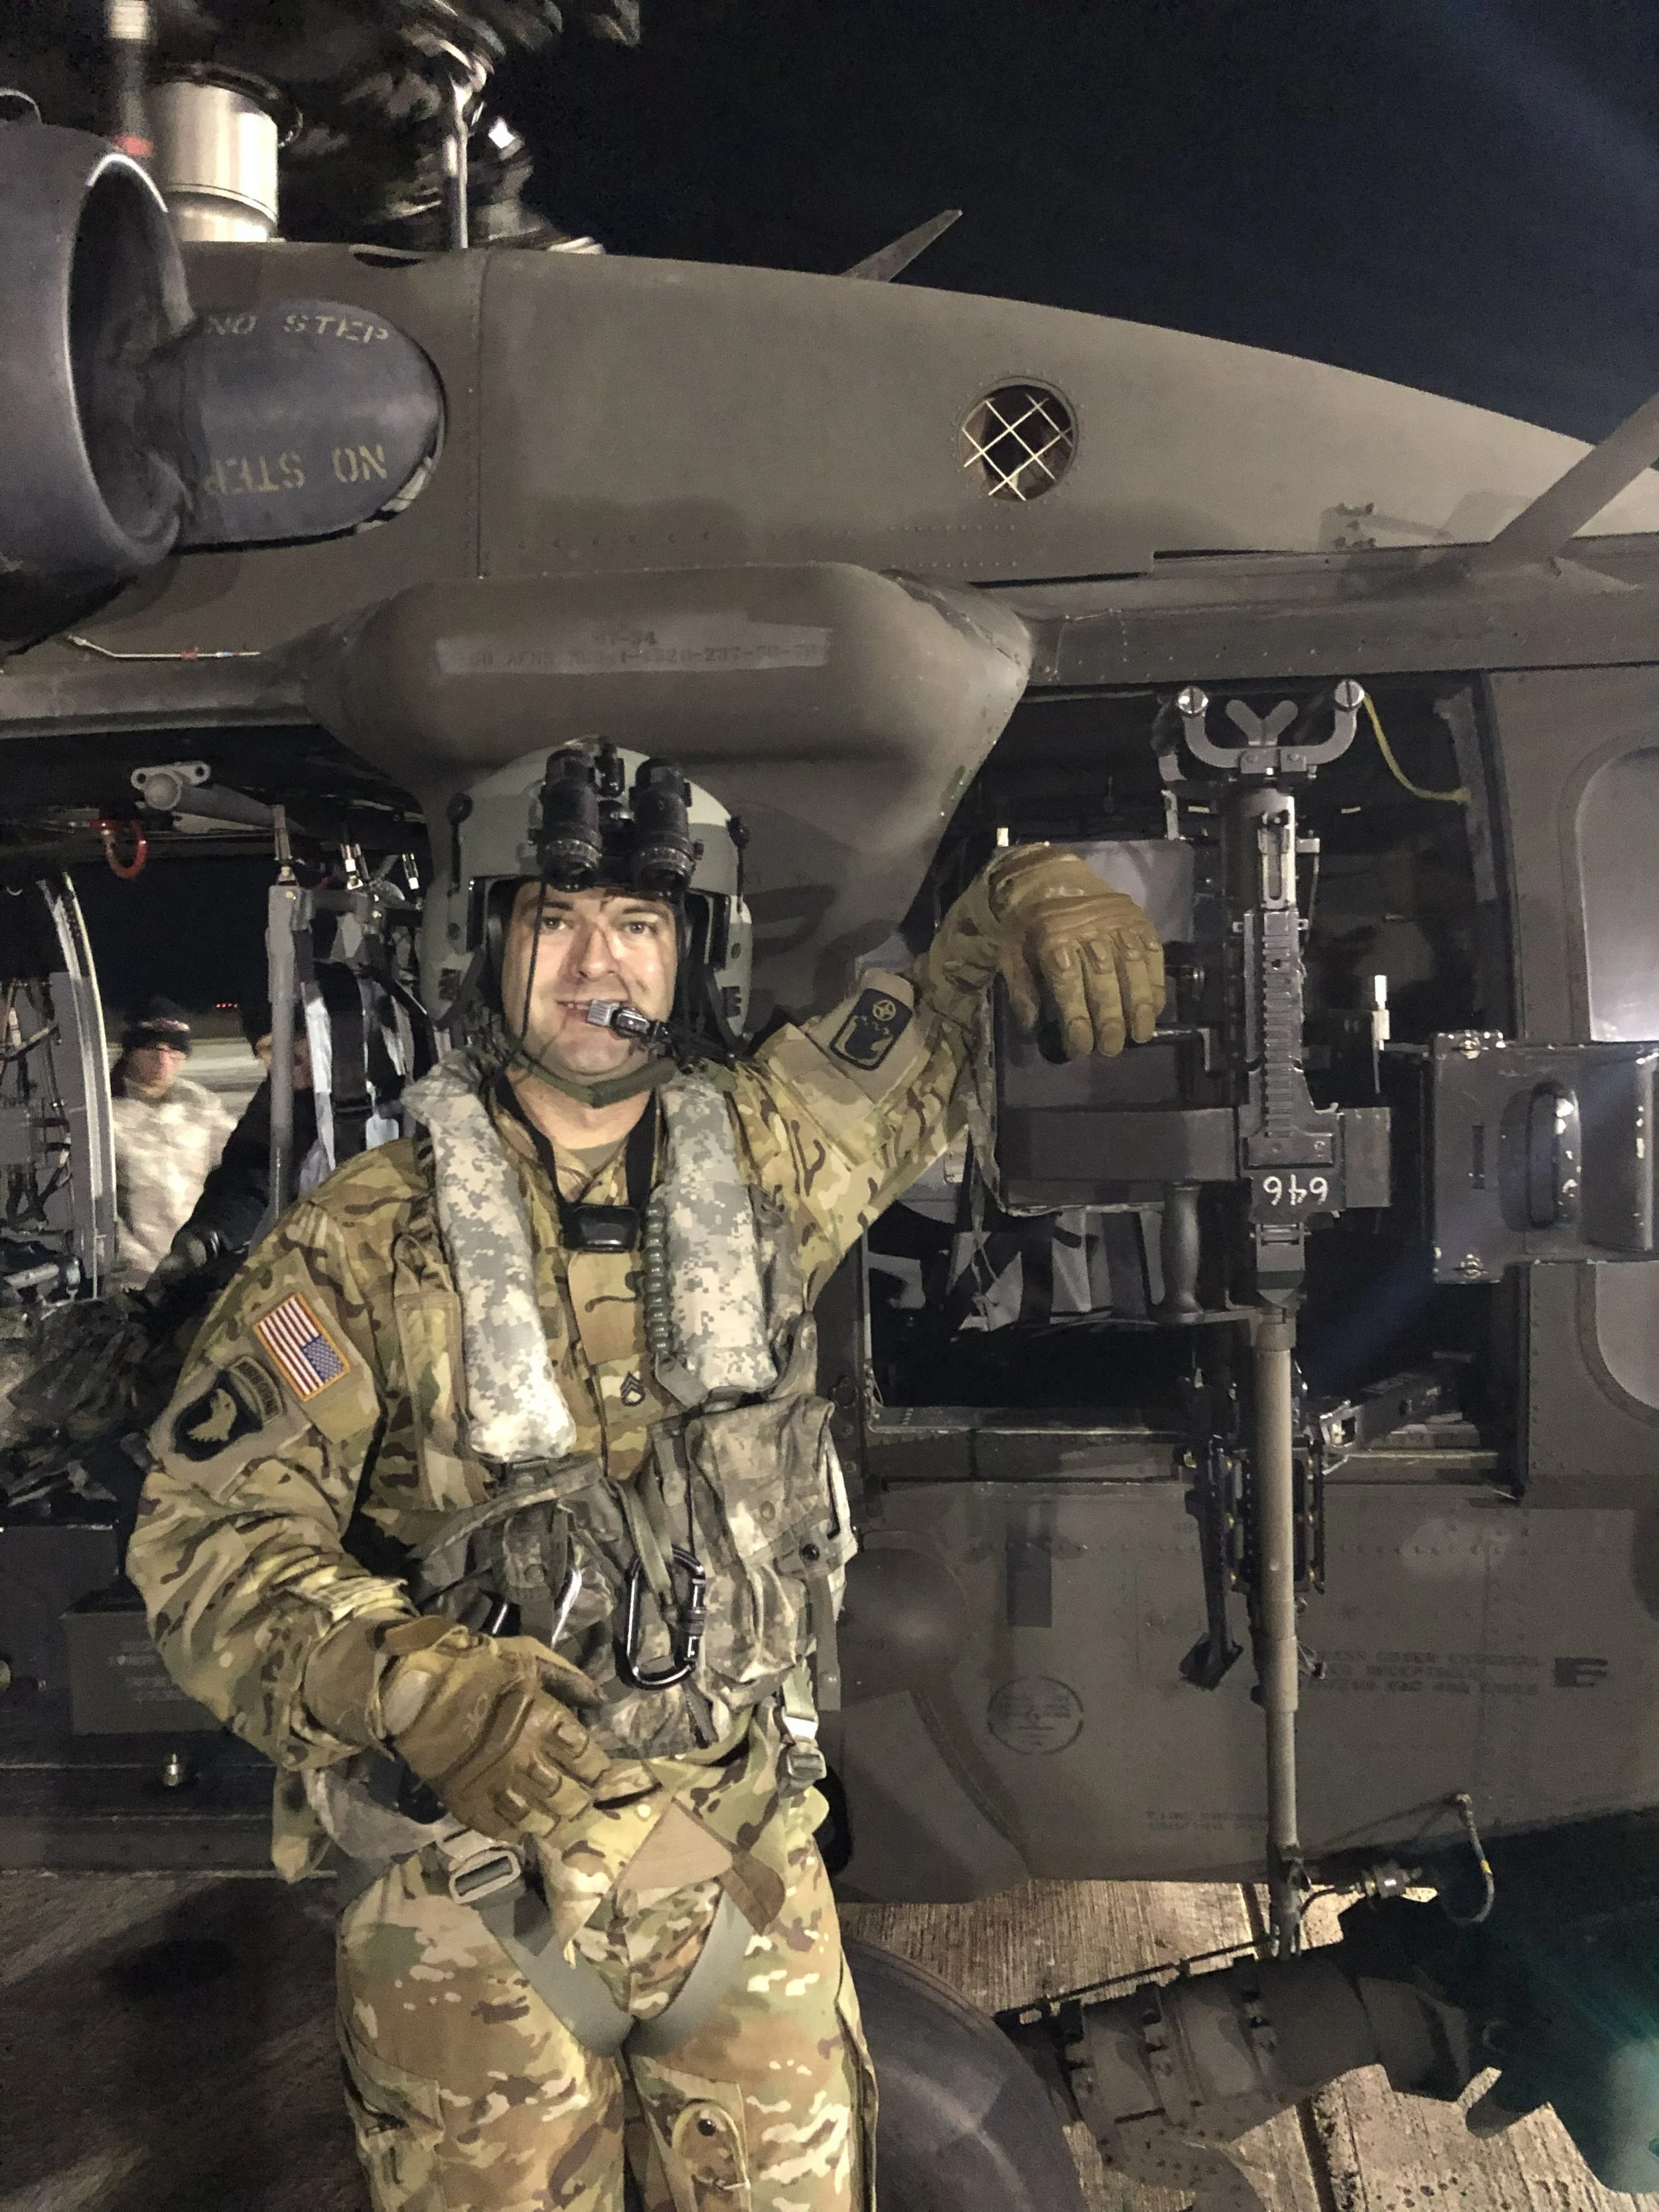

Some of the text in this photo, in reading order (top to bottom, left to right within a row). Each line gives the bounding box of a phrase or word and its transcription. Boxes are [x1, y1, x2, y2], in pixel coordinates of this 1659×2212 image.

[208, 313, 390, 343] NO STEP
[203, 444, 388, 496] NO STEP
[1263, 1174, 1328, 1206] 646
